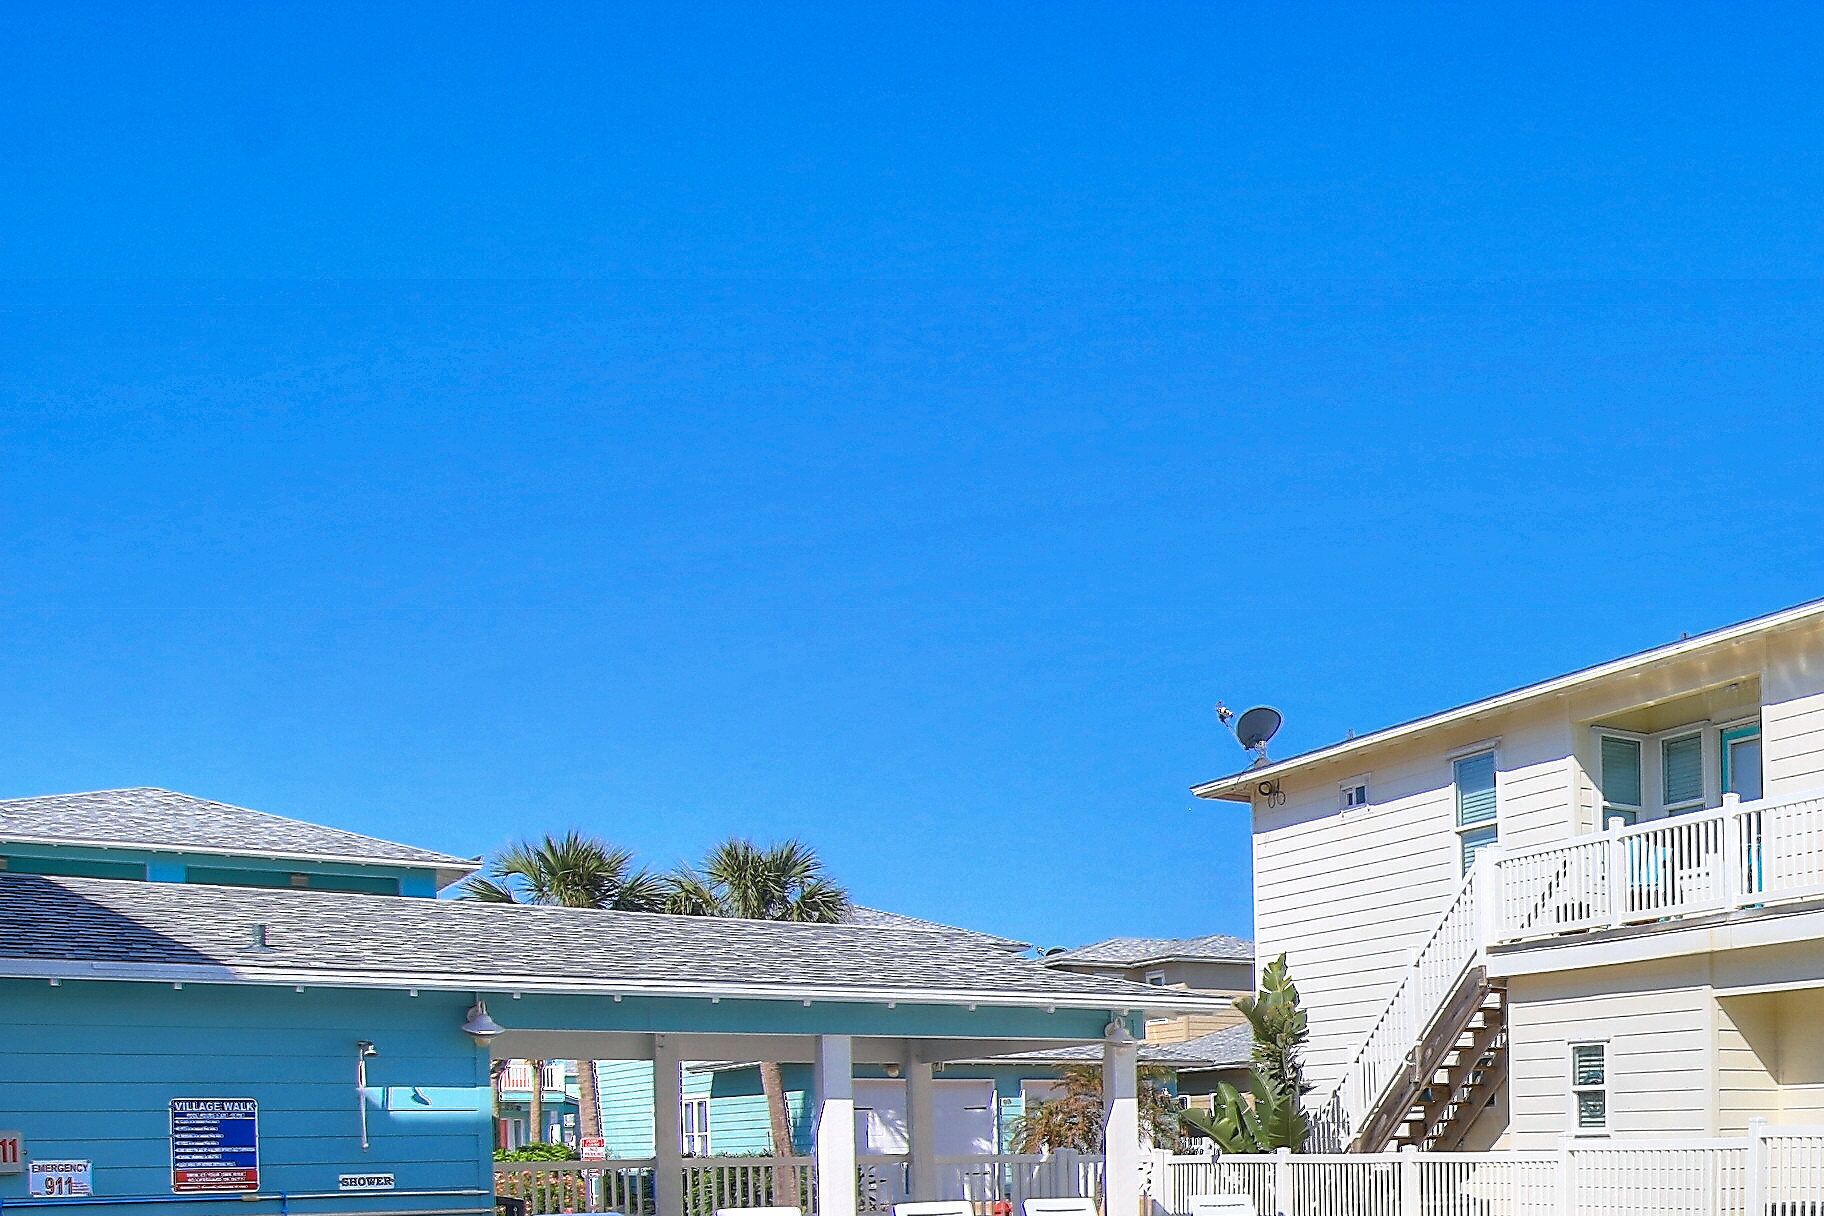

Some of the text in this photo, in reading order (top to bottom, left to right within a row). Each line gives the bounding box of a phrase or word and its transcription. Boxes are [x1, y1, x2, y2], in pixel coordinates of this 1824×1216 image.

[174, 1101, 255, 1111] VILLAGE WALK
[31, 1163, 89, 1173] EMERGENCY
[44, 1176, 73, 1196] 911
[341, 1176, 393, 1187] SHOWER
